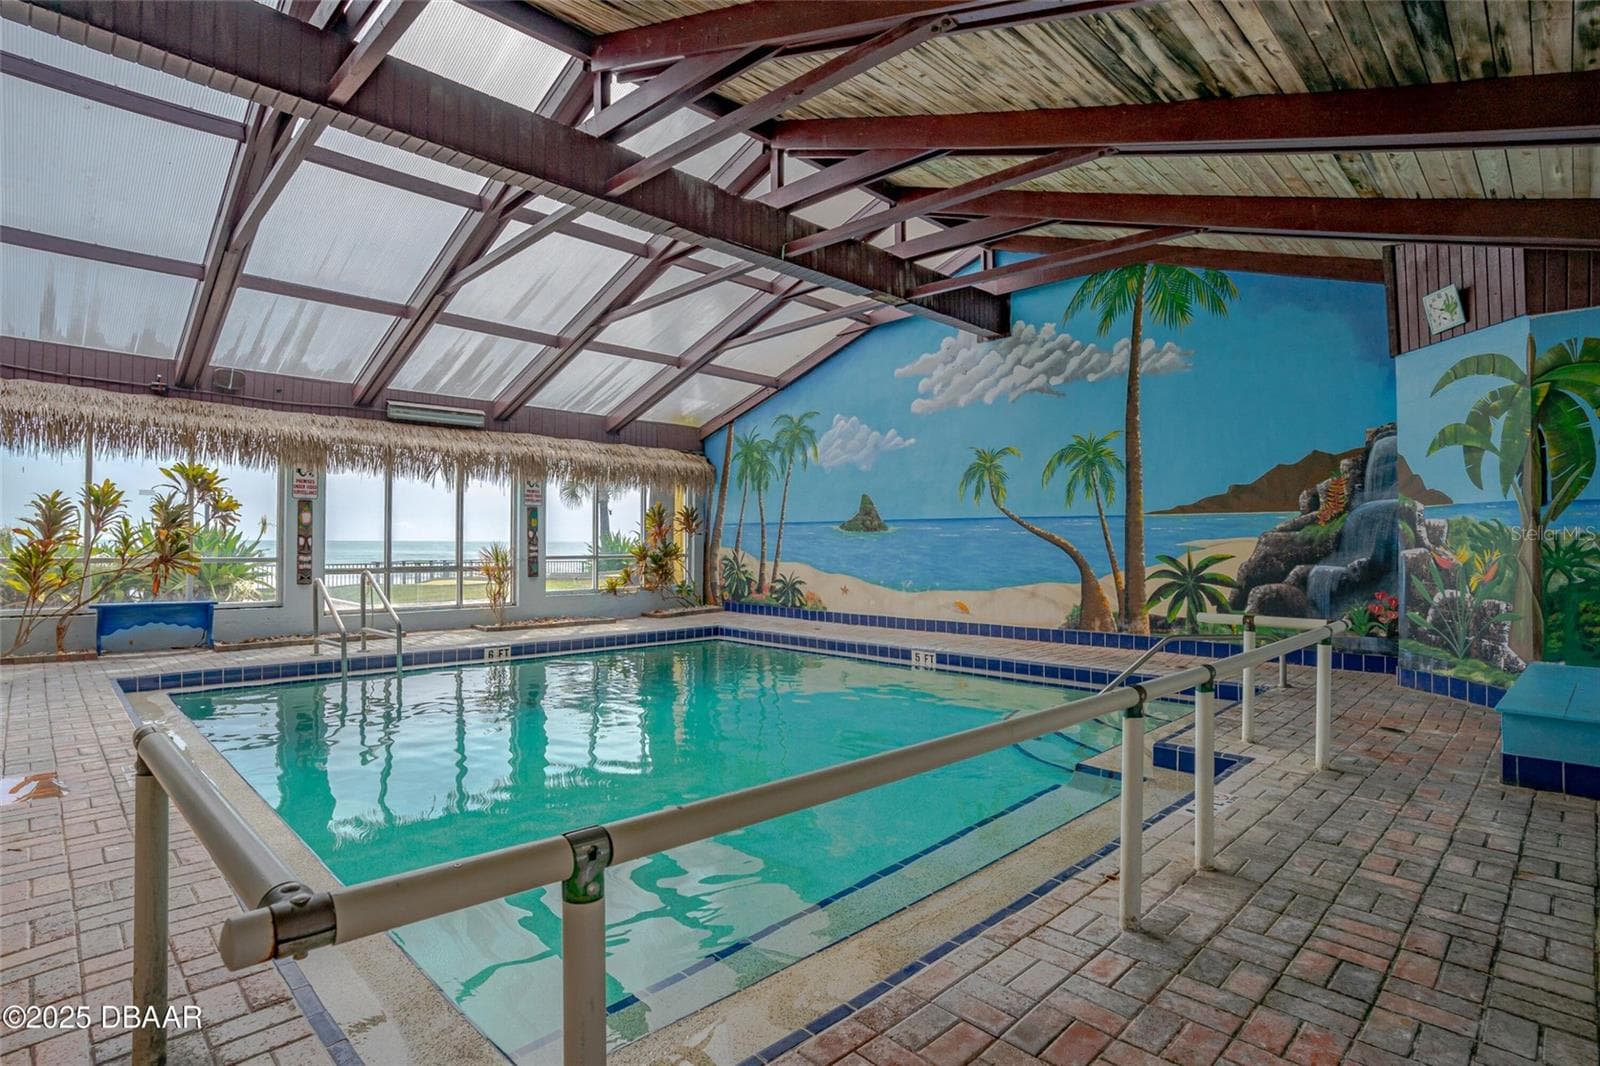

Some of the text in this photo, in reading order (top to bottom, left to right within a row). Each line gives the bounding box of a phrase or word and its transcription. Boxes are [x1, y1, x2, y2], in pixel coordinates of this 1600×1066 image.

[488, 648, 509, 659] 6 FT
[914, 652, 935, 664] 5 FT
